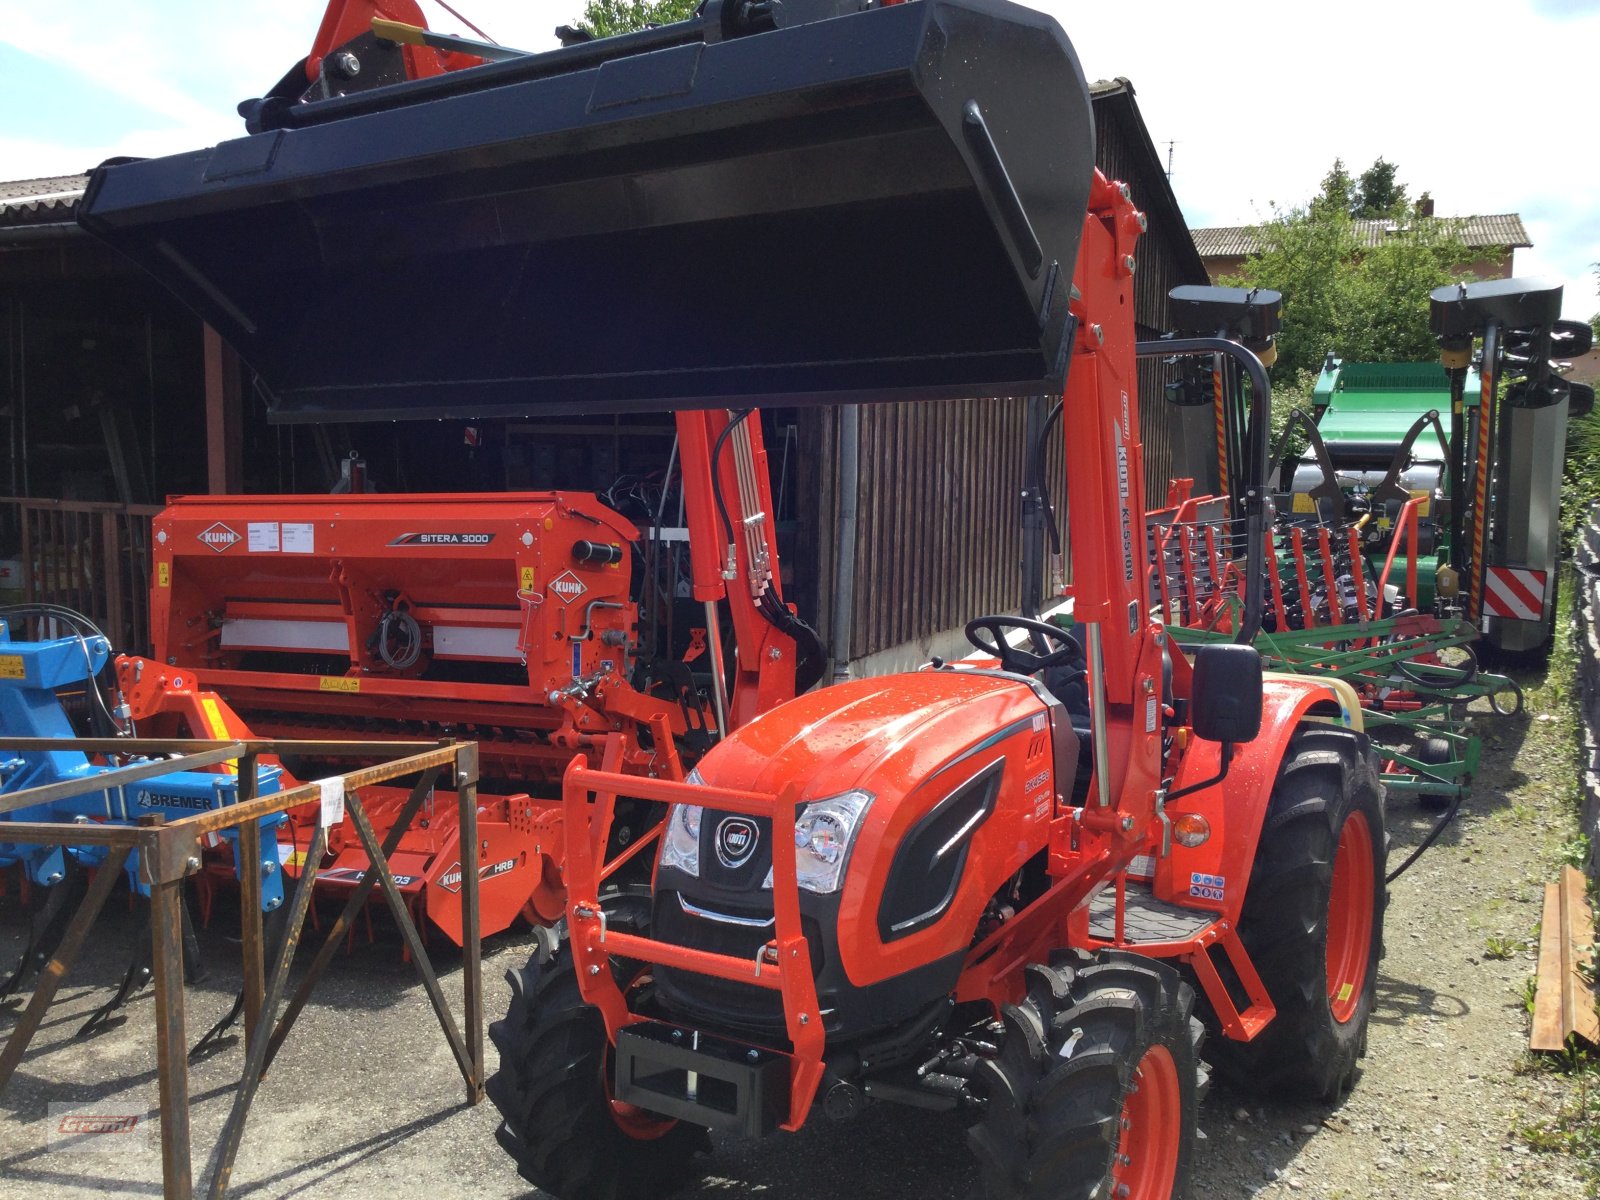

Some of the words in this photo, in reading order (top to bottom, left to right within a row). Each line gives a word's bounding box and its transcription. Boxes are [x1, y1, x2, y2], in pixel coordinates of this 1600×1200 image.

[1118, 446, 1130, 498] KIOTI
[204, 532, 235, 543] KUHN
[420, 534, 459, 543] SITERA
[462, 534, 489, 543] 3000
[555, 581, 582, 594] KUHN
[150, 793, 213, 811] BREMER
[494, 859, 514, 873] HRB
[443, 872, 462, 886] KUH
